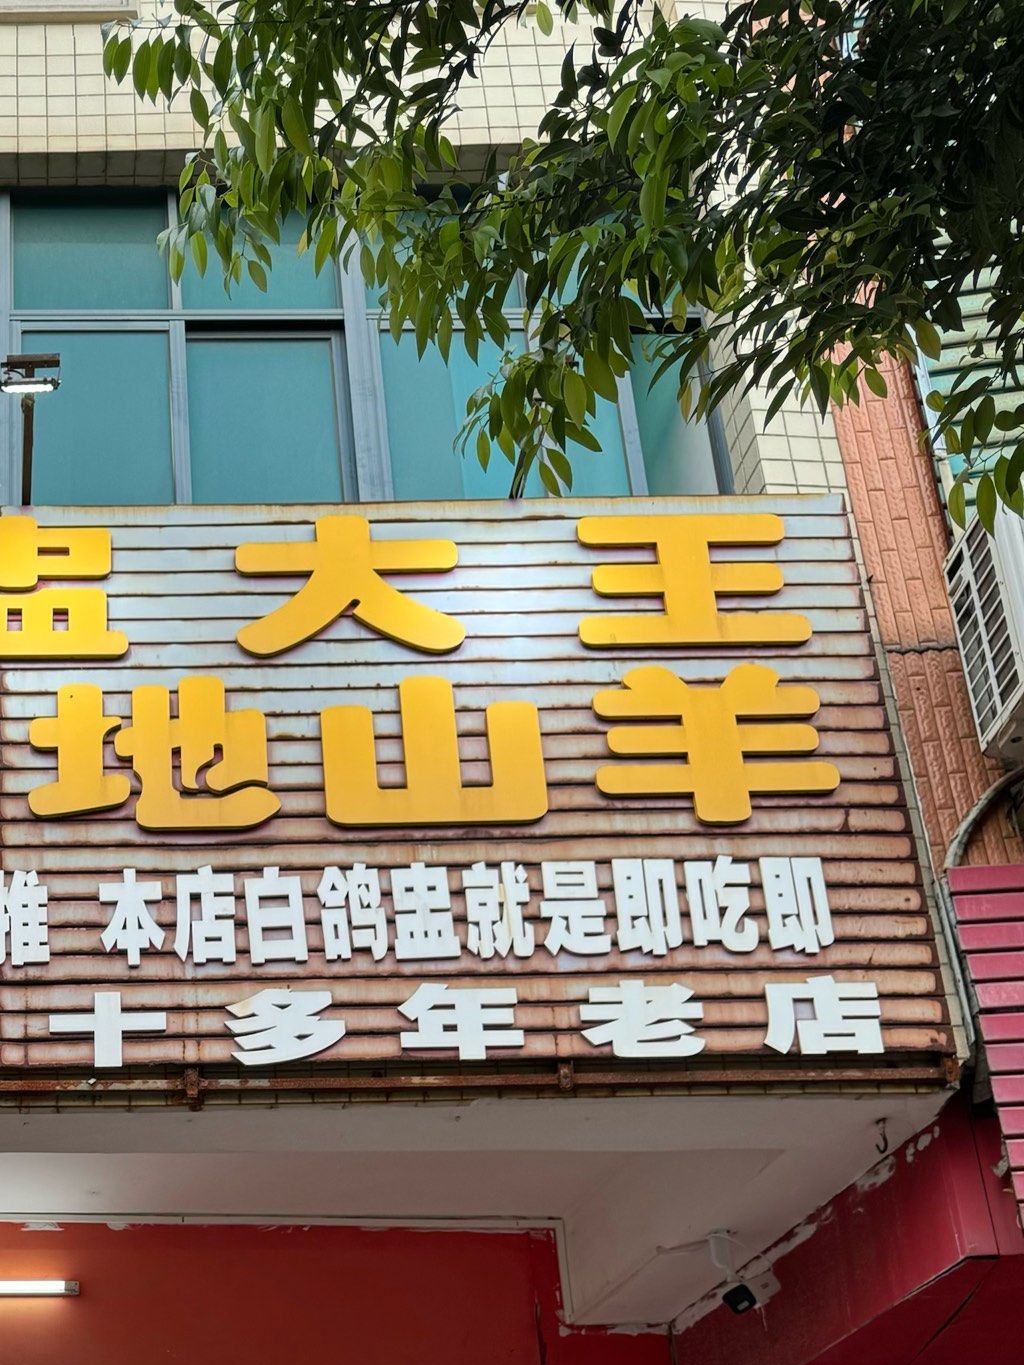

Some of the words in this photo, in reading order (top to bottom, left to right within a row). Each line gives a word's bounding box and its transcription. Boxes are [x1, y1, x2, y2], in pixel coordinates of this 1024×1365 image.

[99, 854, 836, 966] 本店白鸽盅就是即吃即
